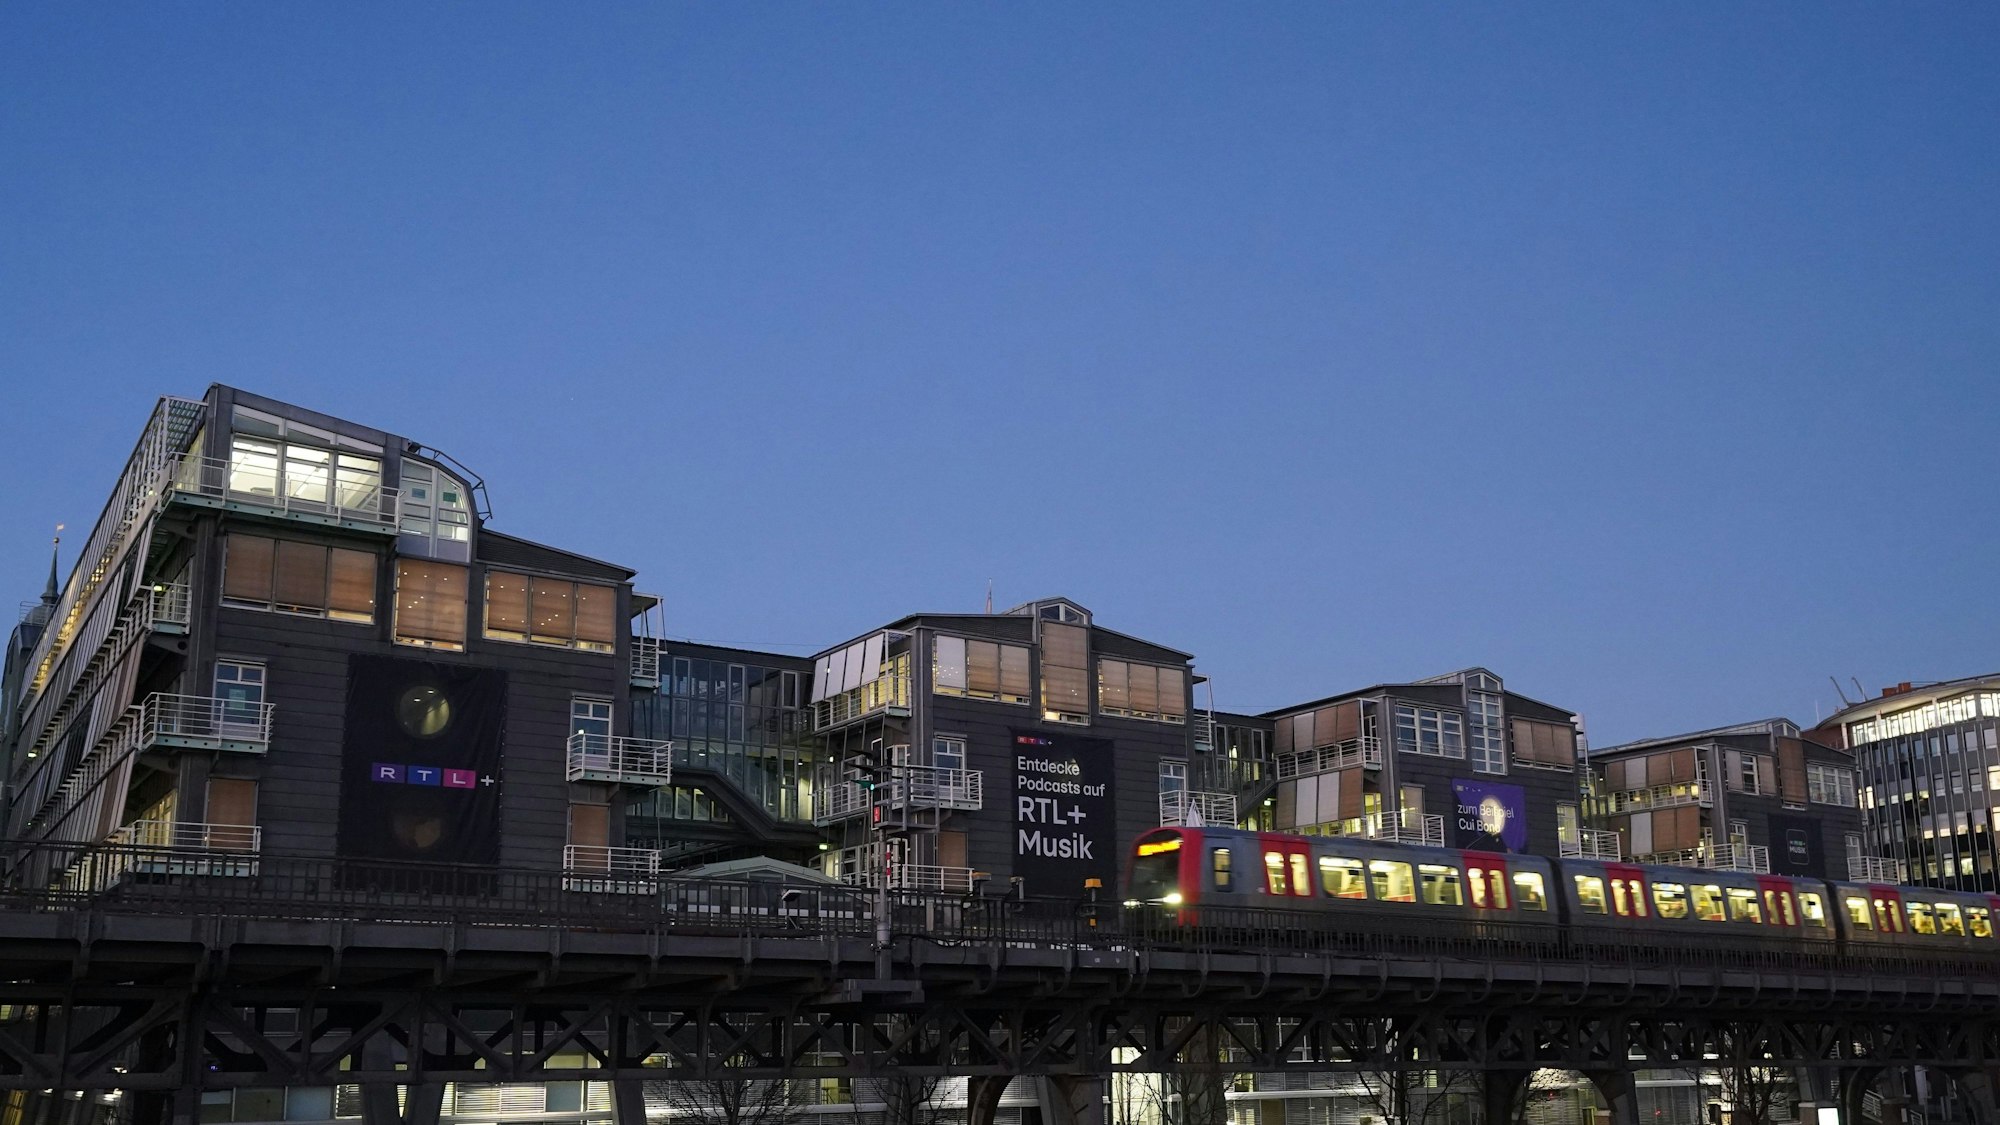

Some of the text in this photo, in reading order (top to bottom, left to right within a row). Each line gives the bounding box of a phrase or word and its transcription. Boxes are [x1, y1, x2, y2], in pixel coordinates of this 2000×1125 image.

[1017, 755, 1080, 776] Entdecke
[379, 766, 495, 787] RTL+
[1018, 775, 1106, 797] Podcasts auf
[1018, 796, 1087, 825] RTL+
[1457, 804, 1478, 816] zum
[1458, 817, 1501, 833] Cui Bono
[1018, 829, 1094, 860] Musik
